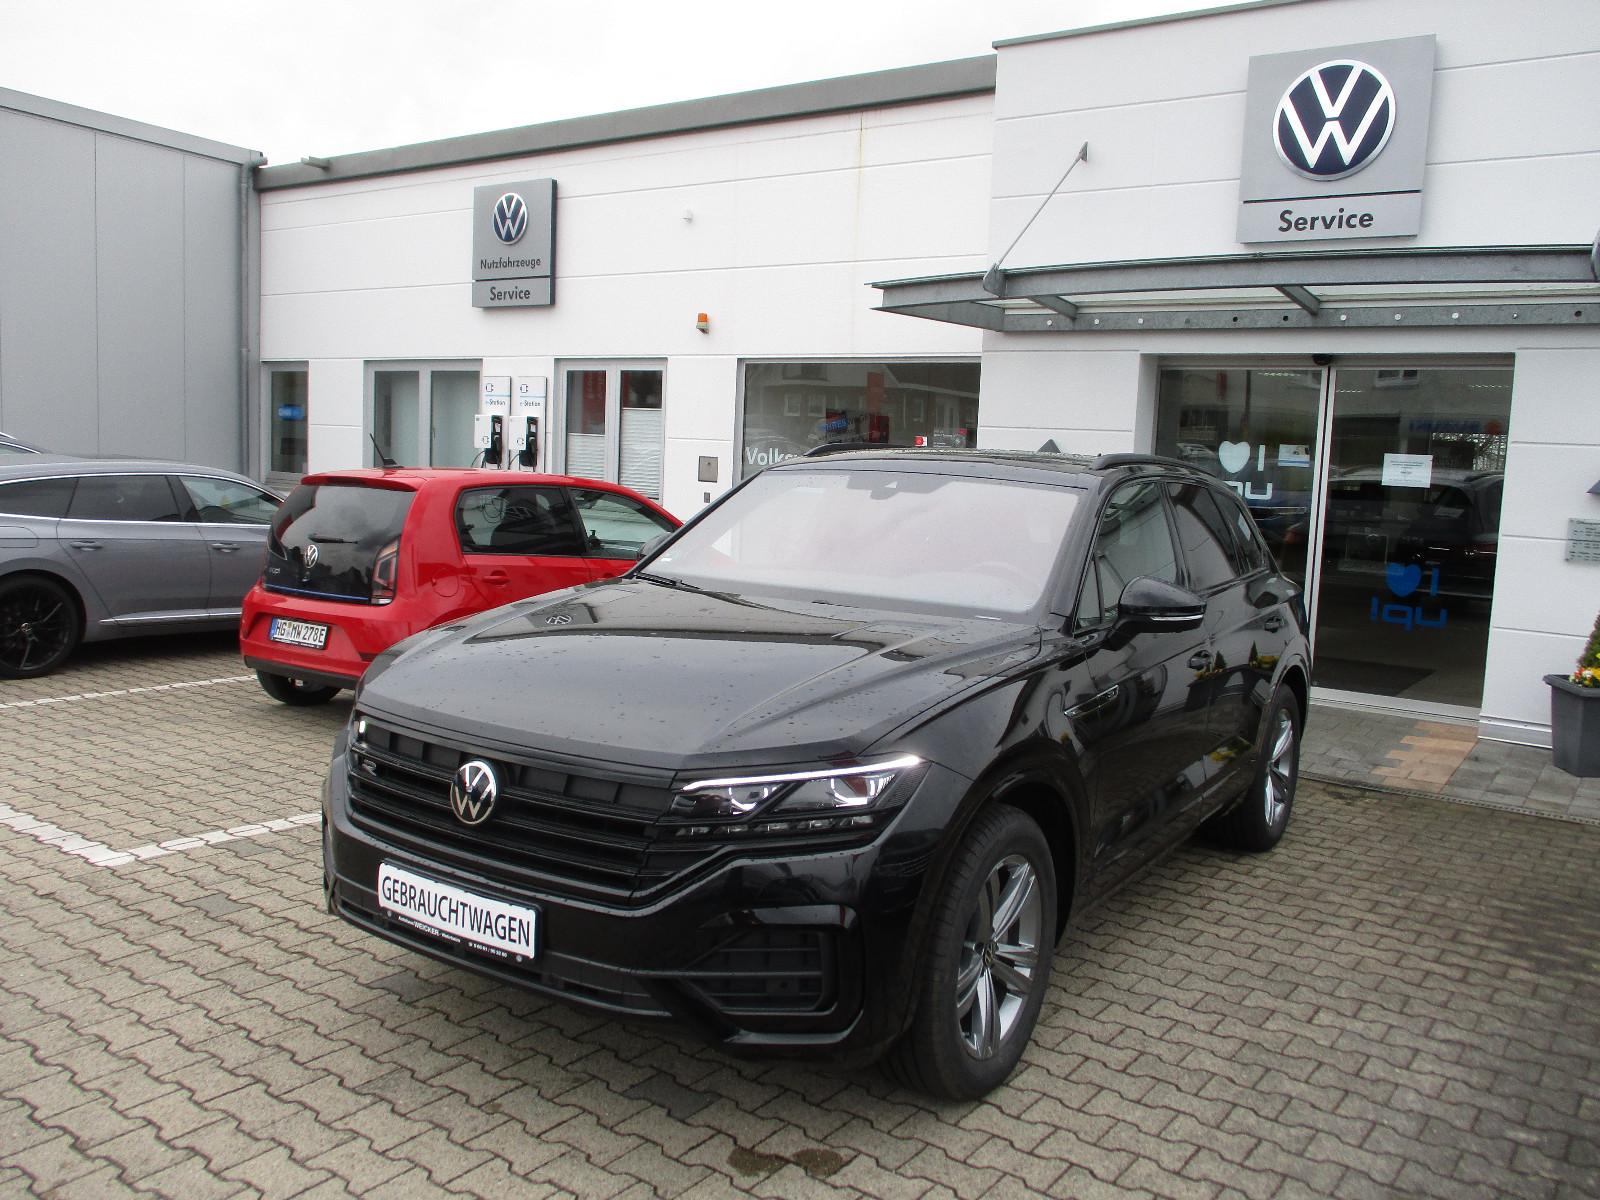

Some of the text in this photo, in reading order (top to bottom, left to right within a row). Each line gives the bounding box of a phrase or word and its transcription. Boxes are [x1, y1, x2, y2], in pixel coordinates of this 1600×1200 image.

[1278, 207, 1374, 233] Service
[480, 256, 541, 270] Nutzfahrzeuge
[489, 285, 531, 301] Service
[276, 619, 326, 643] HG MW 278E
[382, 875, 530, 948] GEBRAUCHTWAGEN
